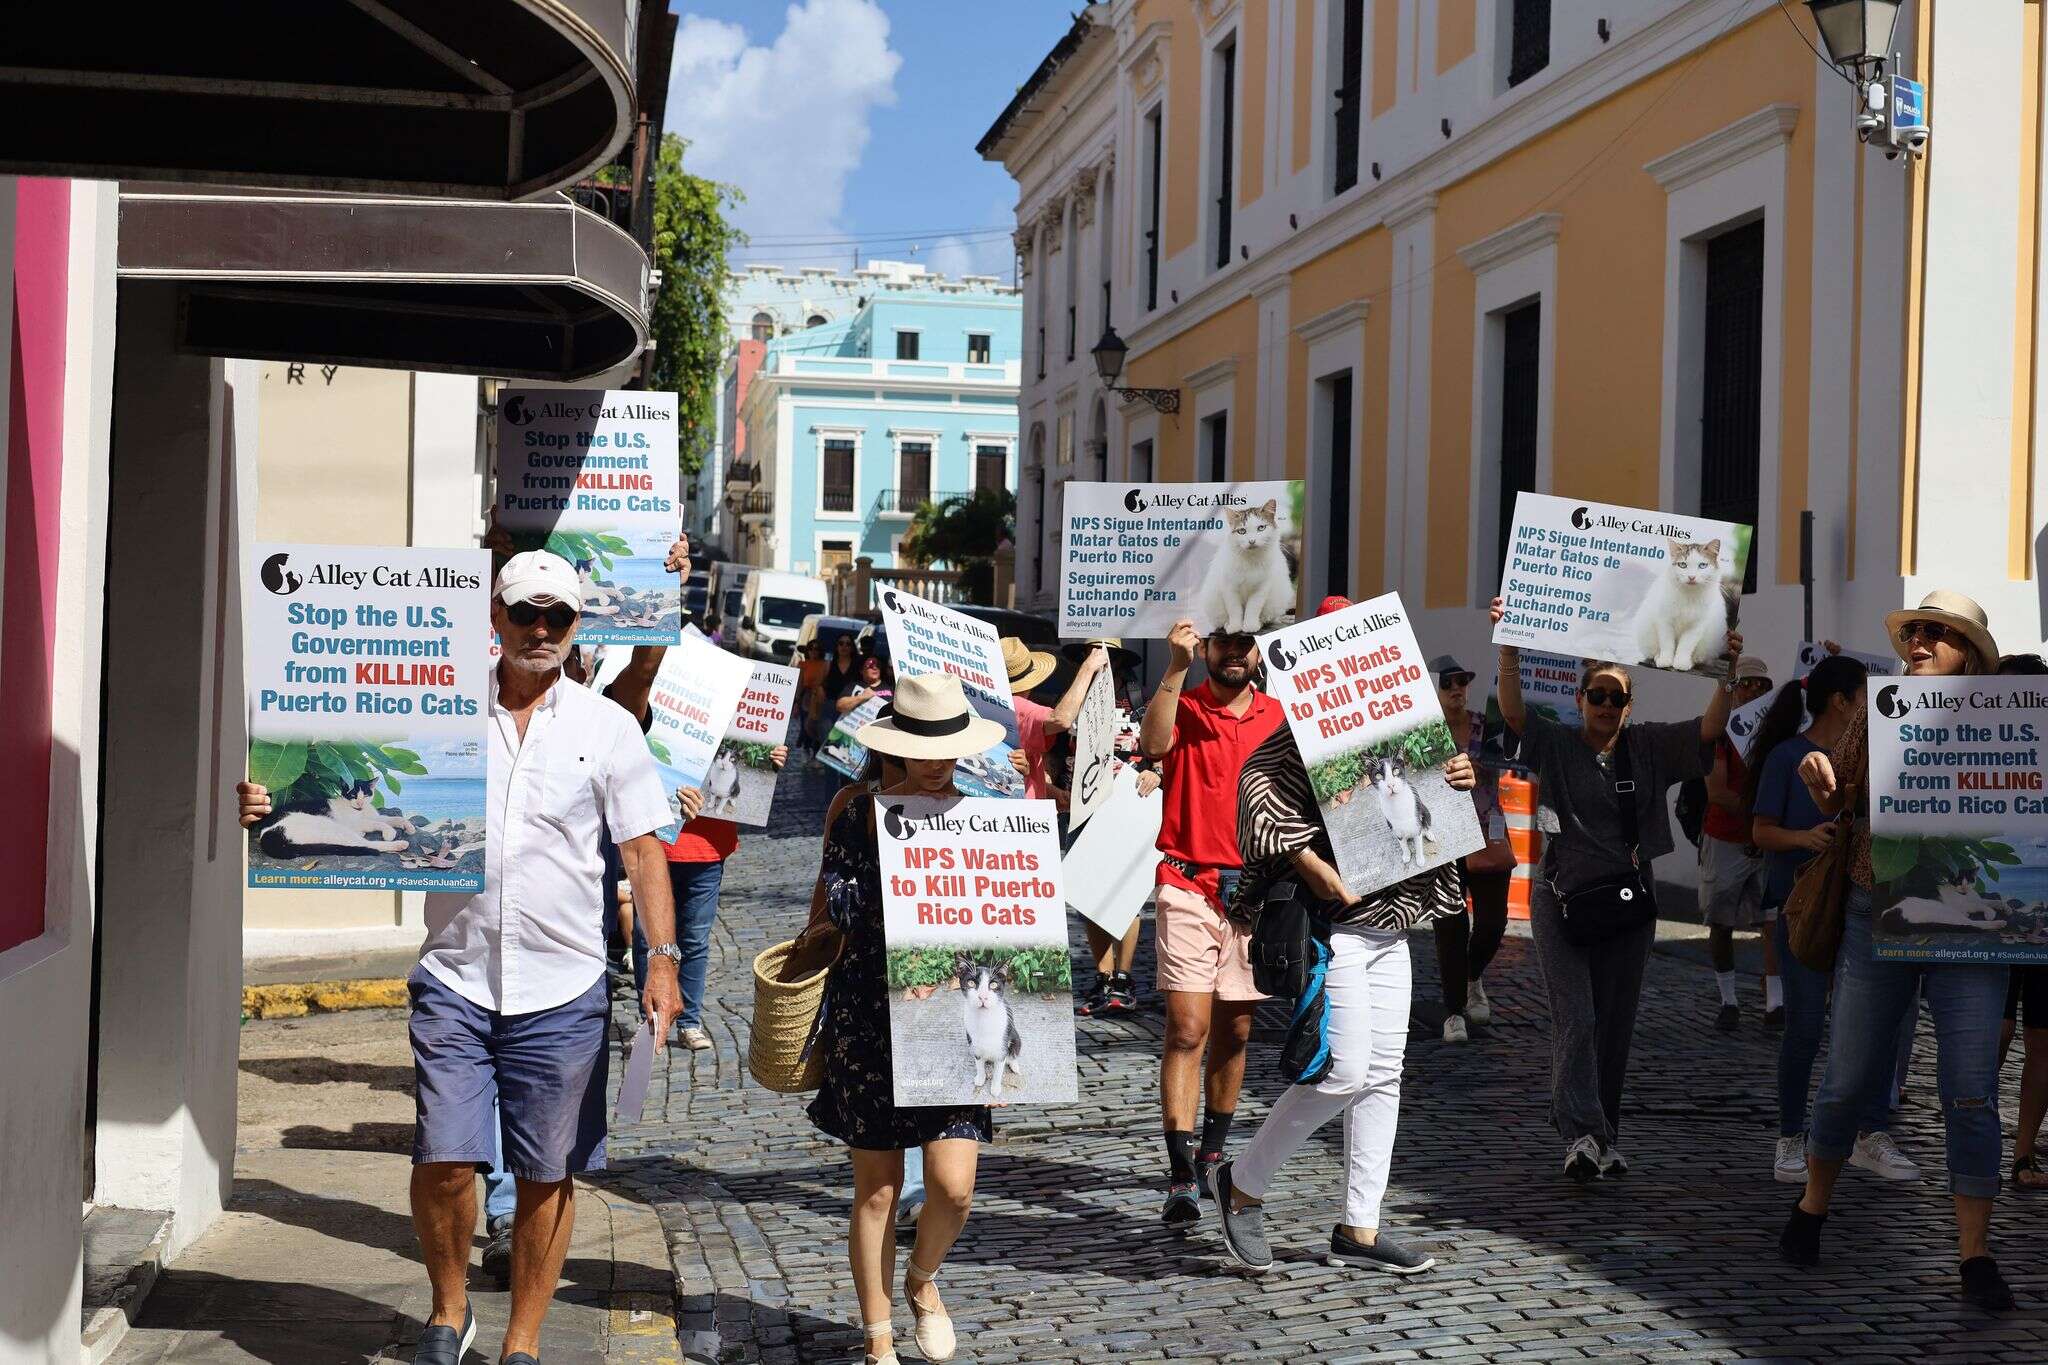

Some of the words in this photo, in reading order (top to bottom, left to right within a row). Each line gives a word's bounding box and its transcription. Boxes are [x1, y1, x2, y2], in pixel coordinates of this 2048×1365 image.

[540, 403, 584, 421] Alley
[588, 403, 618, 419] Cat
[621, 405, 670, 421] Allies
[524, 431, 570, 450] Stop
[576, 432, 608, 448] the
[614, 432, 651, 448] U.S.
[528, 452, 649, 470] Government
[523, 473, 571, 489] from
[576, 474, 653, 490] KILLING
[505, 494, 570, 511] Puerto
[577, 495, 621, 511] Rico
[627, 496, 671, 512] Cats
[1151, 494, 1185, 509] Alley
[1187, 494, 1209, 506] Cat
[1211, 493, 1247, 506] Allies
[1071, 517, 1100, 530] NPS
[1103, 517, 1144, 532] Sigue
[1147, 517, 1223, 530] Intentando
[1596, 515, 1631, 532] Alley
[1632, 519, 1653, 534] Cat
[1656, 523, 1691, 540] Allies
[1070, 534, 1113, 547] Matar
[1118, 534, 1158, 547] Gatos
[1164, 534, 1181, 547] de
[1518, 526, 1546, 542] NPS
[1548, 530, 1588, 548] Sigue
[1590, 536, 1665, 560] Intentando
[1069, 551, 1117, 563] Puerto
[1122, 551, 1153, 563] Rico
[1516, 542, 1557, 560] Matar
[1561, 548, 1599, 566] Gatos
[1604, 555, 1621, 569] de
[308, 564, 367, 590] Alley
[372, 565, 412, 588] Cat
[416, 568, 480, 589] Allies
[1069, 572, 1155, 587] Seguiremos
[1513, 558, 1558, 577] Puerto
[1562, 565, 1593, 582] Rico
[1068, 588, 1138, 601] Luchando
[1144, 588, 1177, 601] Para
[1509, 578, 1592, 603] Seguiremos
[288, 602, 348, 630] Stop
[355, 604, 397, 627] the
[406, 606, 453, 628] U.S.
[1067, 604, 1136, 617] Salvarlos
[1506, 595, 1574, 617] Luchando
[1578, 606, 1610, 623] Para
[909, 604, 938, 623] Alley
[941, 615, 960, 630] Cat
[964, 624, 995, 643] Allies
[1500, 627, 1535, 639] alleycat.org
[1504, 611, 1569, 633] Salvarlos
[292, 632, 450, 657] Government
[573, 633, 603, 642] cat.org
[902, 619, 934, 640] Stop
[936, 631, 959, 648] the
[962, 640, 988, 659] U.S.
[1298, 634, 1334, 656] Alley
[1335, 623, 1361, 642] Cat
[1362, 611, 1401, 635] Allies
[908, 635, 989, 673] Government
[1520, 654, 1576, 669] overnment
[284, 661, 347, 683] from
[355, 663, 455, 686] KILLING
[751, 672, 761, 680] at
[764, 673, 792, 686] Allies
[908, 649, 940, 670] from
[944, 661, 995, 689] KILLING
[1292, 663, 1336, 694] NPS
[1337, 644, 1402, 678] Wants
[1535, 668, 1577, 682] KILLING
[655, 676, 712, 708] ernment
[1291, 701, 1314, 721] to
[1317, 684, 1352, 713] Kill
[1355, 663, 1421, 698] Puerto
[1534, 681, 1557, 693] Rico
[261, 690, 347, 713] Puerto
[356, 692, 413, 714] Rico
[420, 693, 478, 716] Cats
[654, 691, 710, 725] KILLING
[980, 688, 1010, 710] Cats
[1915, 692, 1965, 712] Alley
[1970, 691, 2003, 709] Cat
[2006, 691, 2048, 709] Allie
[737, 701, 785, 721] Puerto
[1318, 710, 1364, 739] Rico
[1368, 693, 1413, 721] Cats
[683, 722, 715, 745] Cats
[736, 716, 768, 732] Cats
[1899, 724, 1949, 746] Stop
[1956, 724, 1992, 742] the
[1999, 724, 2040, 742] U.S.
[1903, 748, 2038, 766] Government
[1898, 772, 1950, 790] from
[1958, 772, 2043, 790] KILLING
[1879, 796, 1951, 814] Puerto
[1958, 796, 2007, 814] Rico
[2014, 796, 2048, 814] Cat
[921, 814, 965, 835] Alley
[969, 815, 998, 833] Cat
[1003, 816, 1050, 834] Allies
[904, 847, 955, 870] NPS
[962, 848, 1039, 871] Wants
[255, 874, 286, 884] Learn
[290, 876, 321, 884] more:
[324, 875, 386, 887] alleycat.org
[397, 878, 478, 887] #SaveSanJuanCats
[890, 875, 916, 897] to
[925, 875, 966, 897] Kill
[975, 876, 1055, 898] Puerto
[917, 903, 973, 925] Rico
[981, 903, 1036, 925] Cats
[1877, 948, 1904, 956] Learn
[1935, 949, 1989, 960] alleycat.org
[1997, 951, 2048, 960] #SaveSanJua
